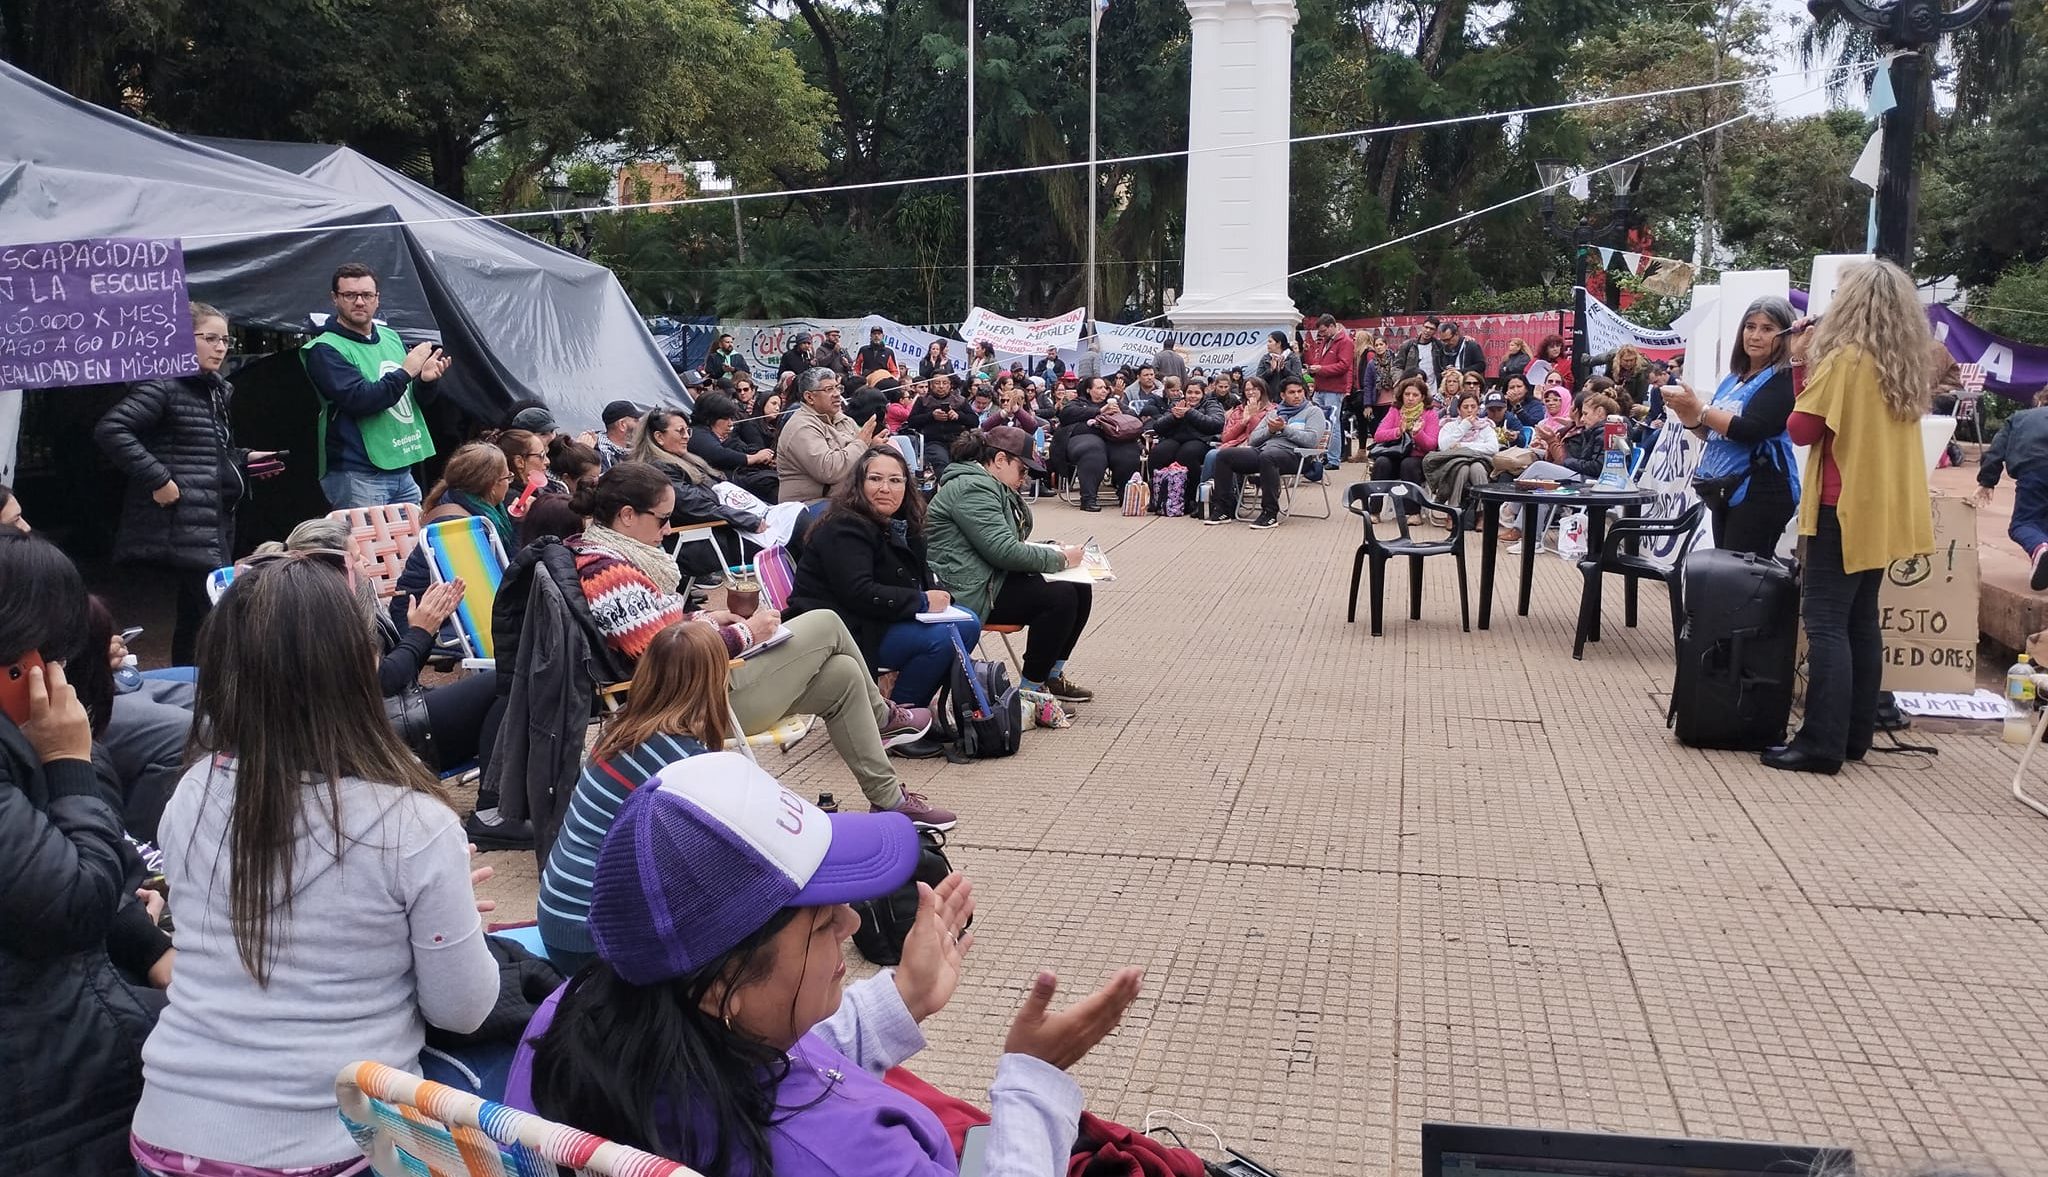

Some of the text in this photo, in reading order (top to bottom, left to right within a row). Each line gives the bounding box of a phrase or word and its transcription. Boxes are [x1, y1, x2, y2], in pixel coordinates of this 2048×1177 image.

[30, 275, 66, 303] LA
[90, 268, 183, 295] ESCUELA
[93, 307, 110, 328] X
[55, 336, 68, 353] A
[75, 335, 102, 355] 60
[1109, 328, 1261, 347] AUTOCONVOCADOS
[84, 359, 111, 380] EN
